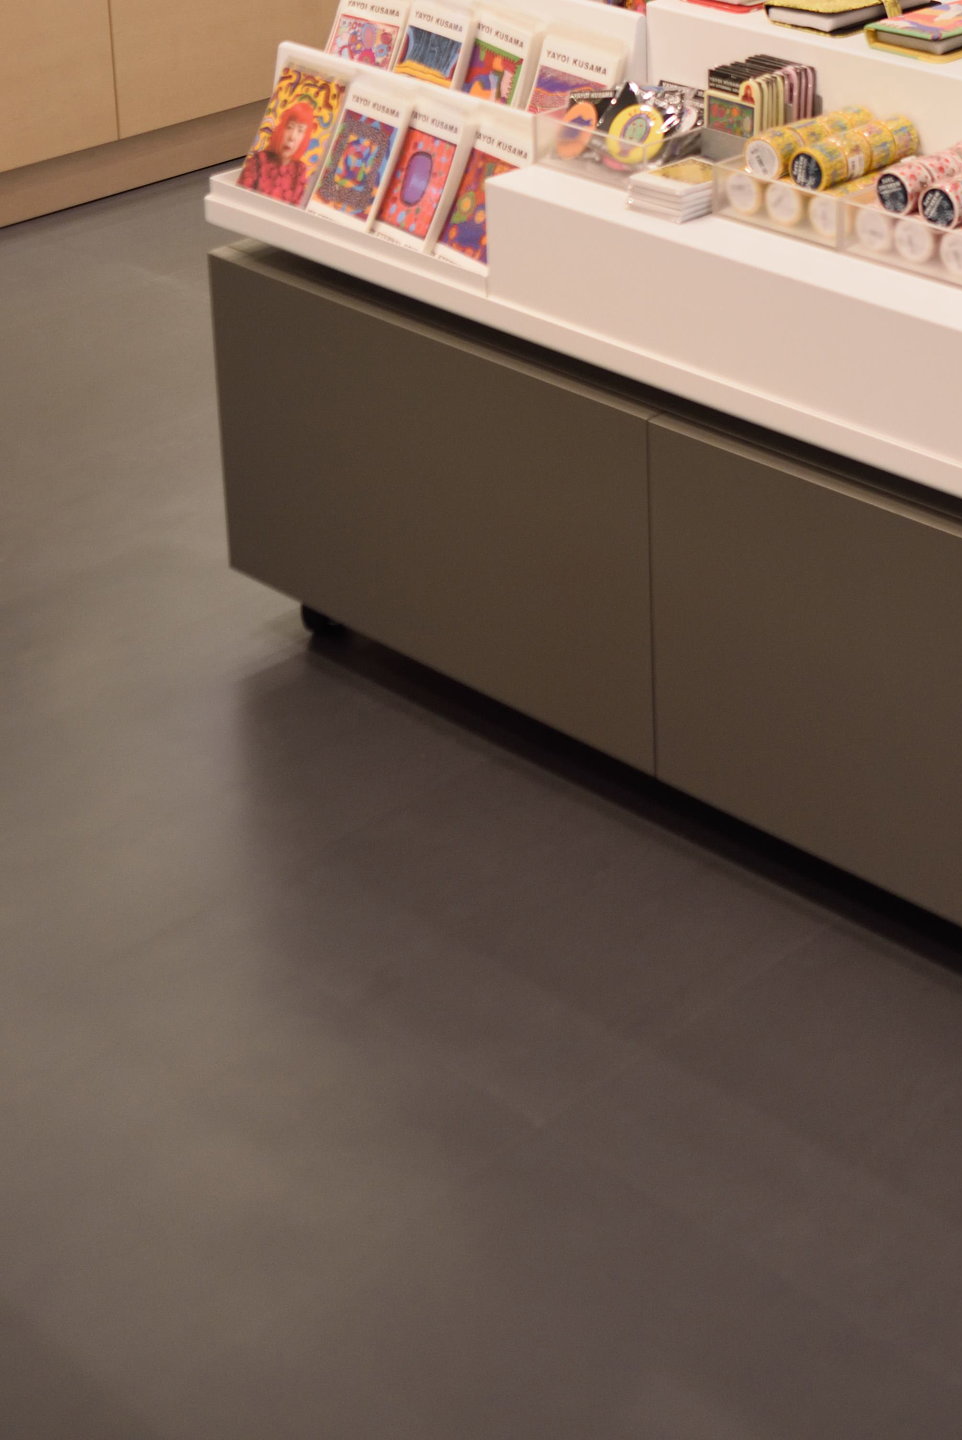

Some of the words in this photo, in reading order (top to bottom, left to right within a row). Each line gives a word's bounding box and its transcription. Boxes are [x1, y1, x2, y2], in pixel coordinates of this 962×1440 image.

[347, 0, 368, 10] YAYOI
[370, 5, 400, 17] KUSAMA
[415, 11, 434, 22] YAYOI
[435, 16, 463, 32] KUSAMA
[495, 31, 524, 48] KUSAMA
[546, 49, 570, 63] YAYOI
[572, 58, 607, 76] KUSAMA
[371, 101, 400, 119] KUSAMA
[431, 117, 458, 134] KUSAMA
[497, 141, 528, 160] KUSAMA
